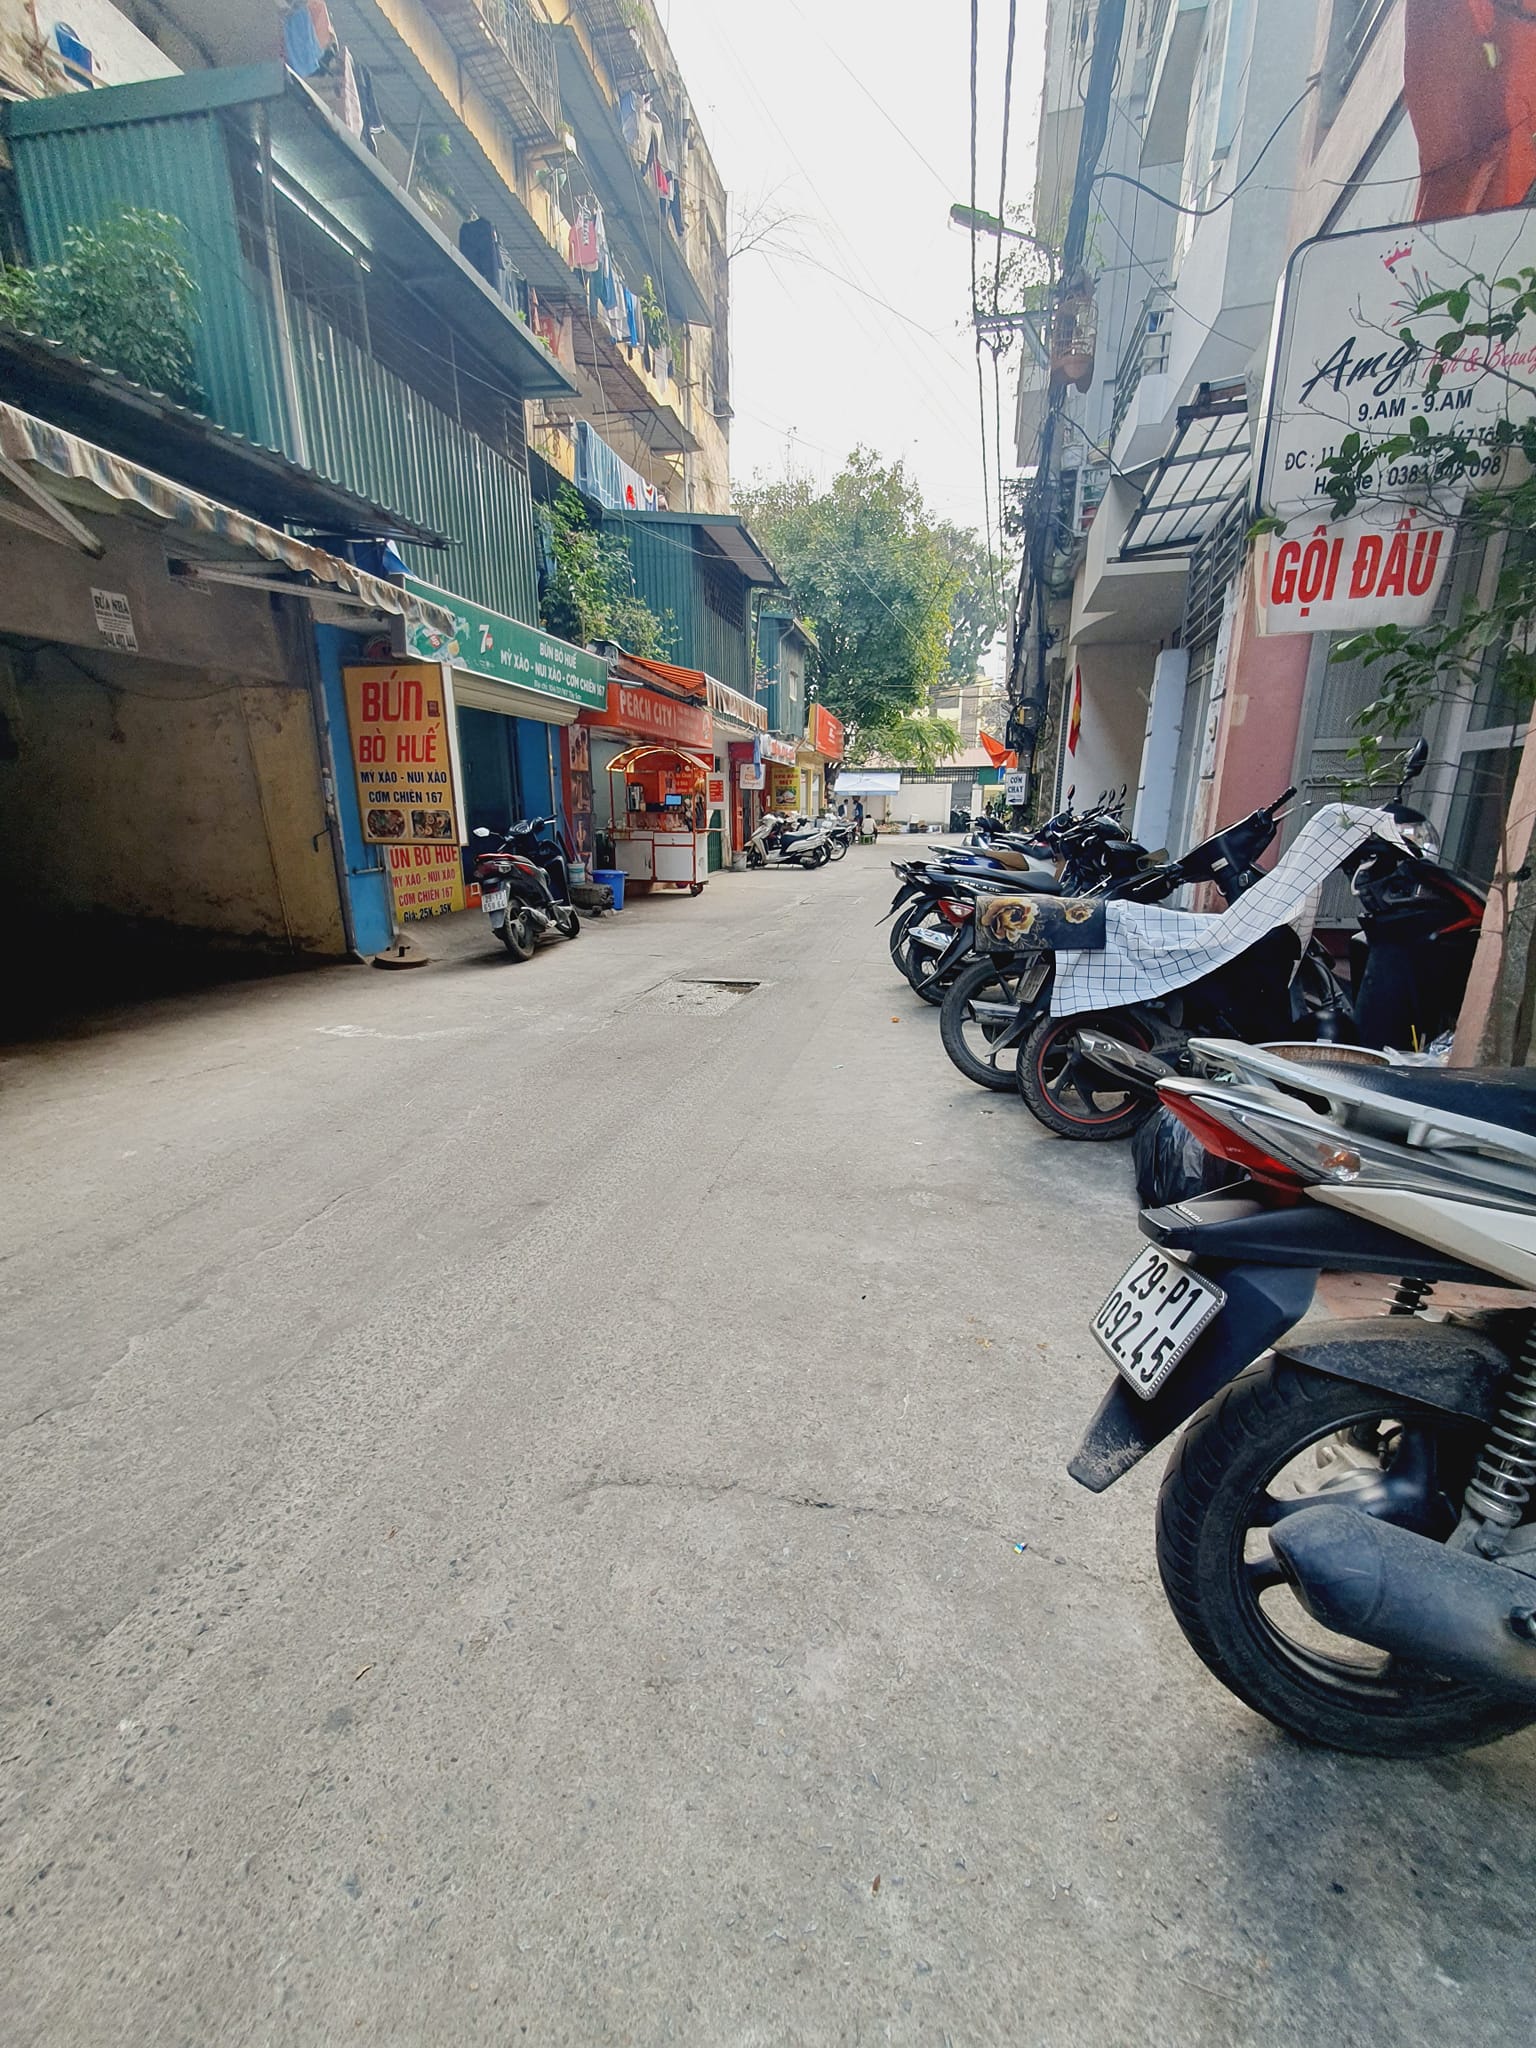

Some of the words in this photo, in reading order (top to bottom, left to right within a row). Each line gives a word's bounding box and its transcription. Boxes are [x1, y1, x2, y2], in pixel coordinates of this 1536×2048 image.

[1299, 336, 1415, 403] Amy
[1358, 397, 1405, 422] 9.AM
[1424, 388, 1473, 414] 9.AM
[1271, 524, 1344, 617] GỘI
[1348, 508, 1444, 599] ĐẦU
[514, 652, 530, 673] XÀO
[535, 662, 548, 678] NUI
[548, 665, 562, 683] XÀO
[566, 673, 580, 690] CƠM
[540, 641, 554, 661] BÚN
[554, 647, 565, 664] BÒ
[564, 651, 577, 670] HUẾ
[362, 669, 423, 723] BÚN
[653, 701, 672, 728] CITY
[359, 727, 386, 763] BÒ
[397, 722, 441, 763] HUẾ
[378, 768, 398, 784] XÀO
[406, 771, 425, 784] NUI
[427, 768, 447, 784] XÀO
[368, 790, 391, 804] CƠM
[393, 788, 423, 804] CHIÊN
[425, 791, 443, 804] 167
[427, 870, 441, 883] NUI
[398, 892, 416, 907] CƠM
[441, 886, 453, 899] 167
[1127, 1254, 1203, 1331] 29-P1
[1096, 1291, 1176, 1383] 092.45
